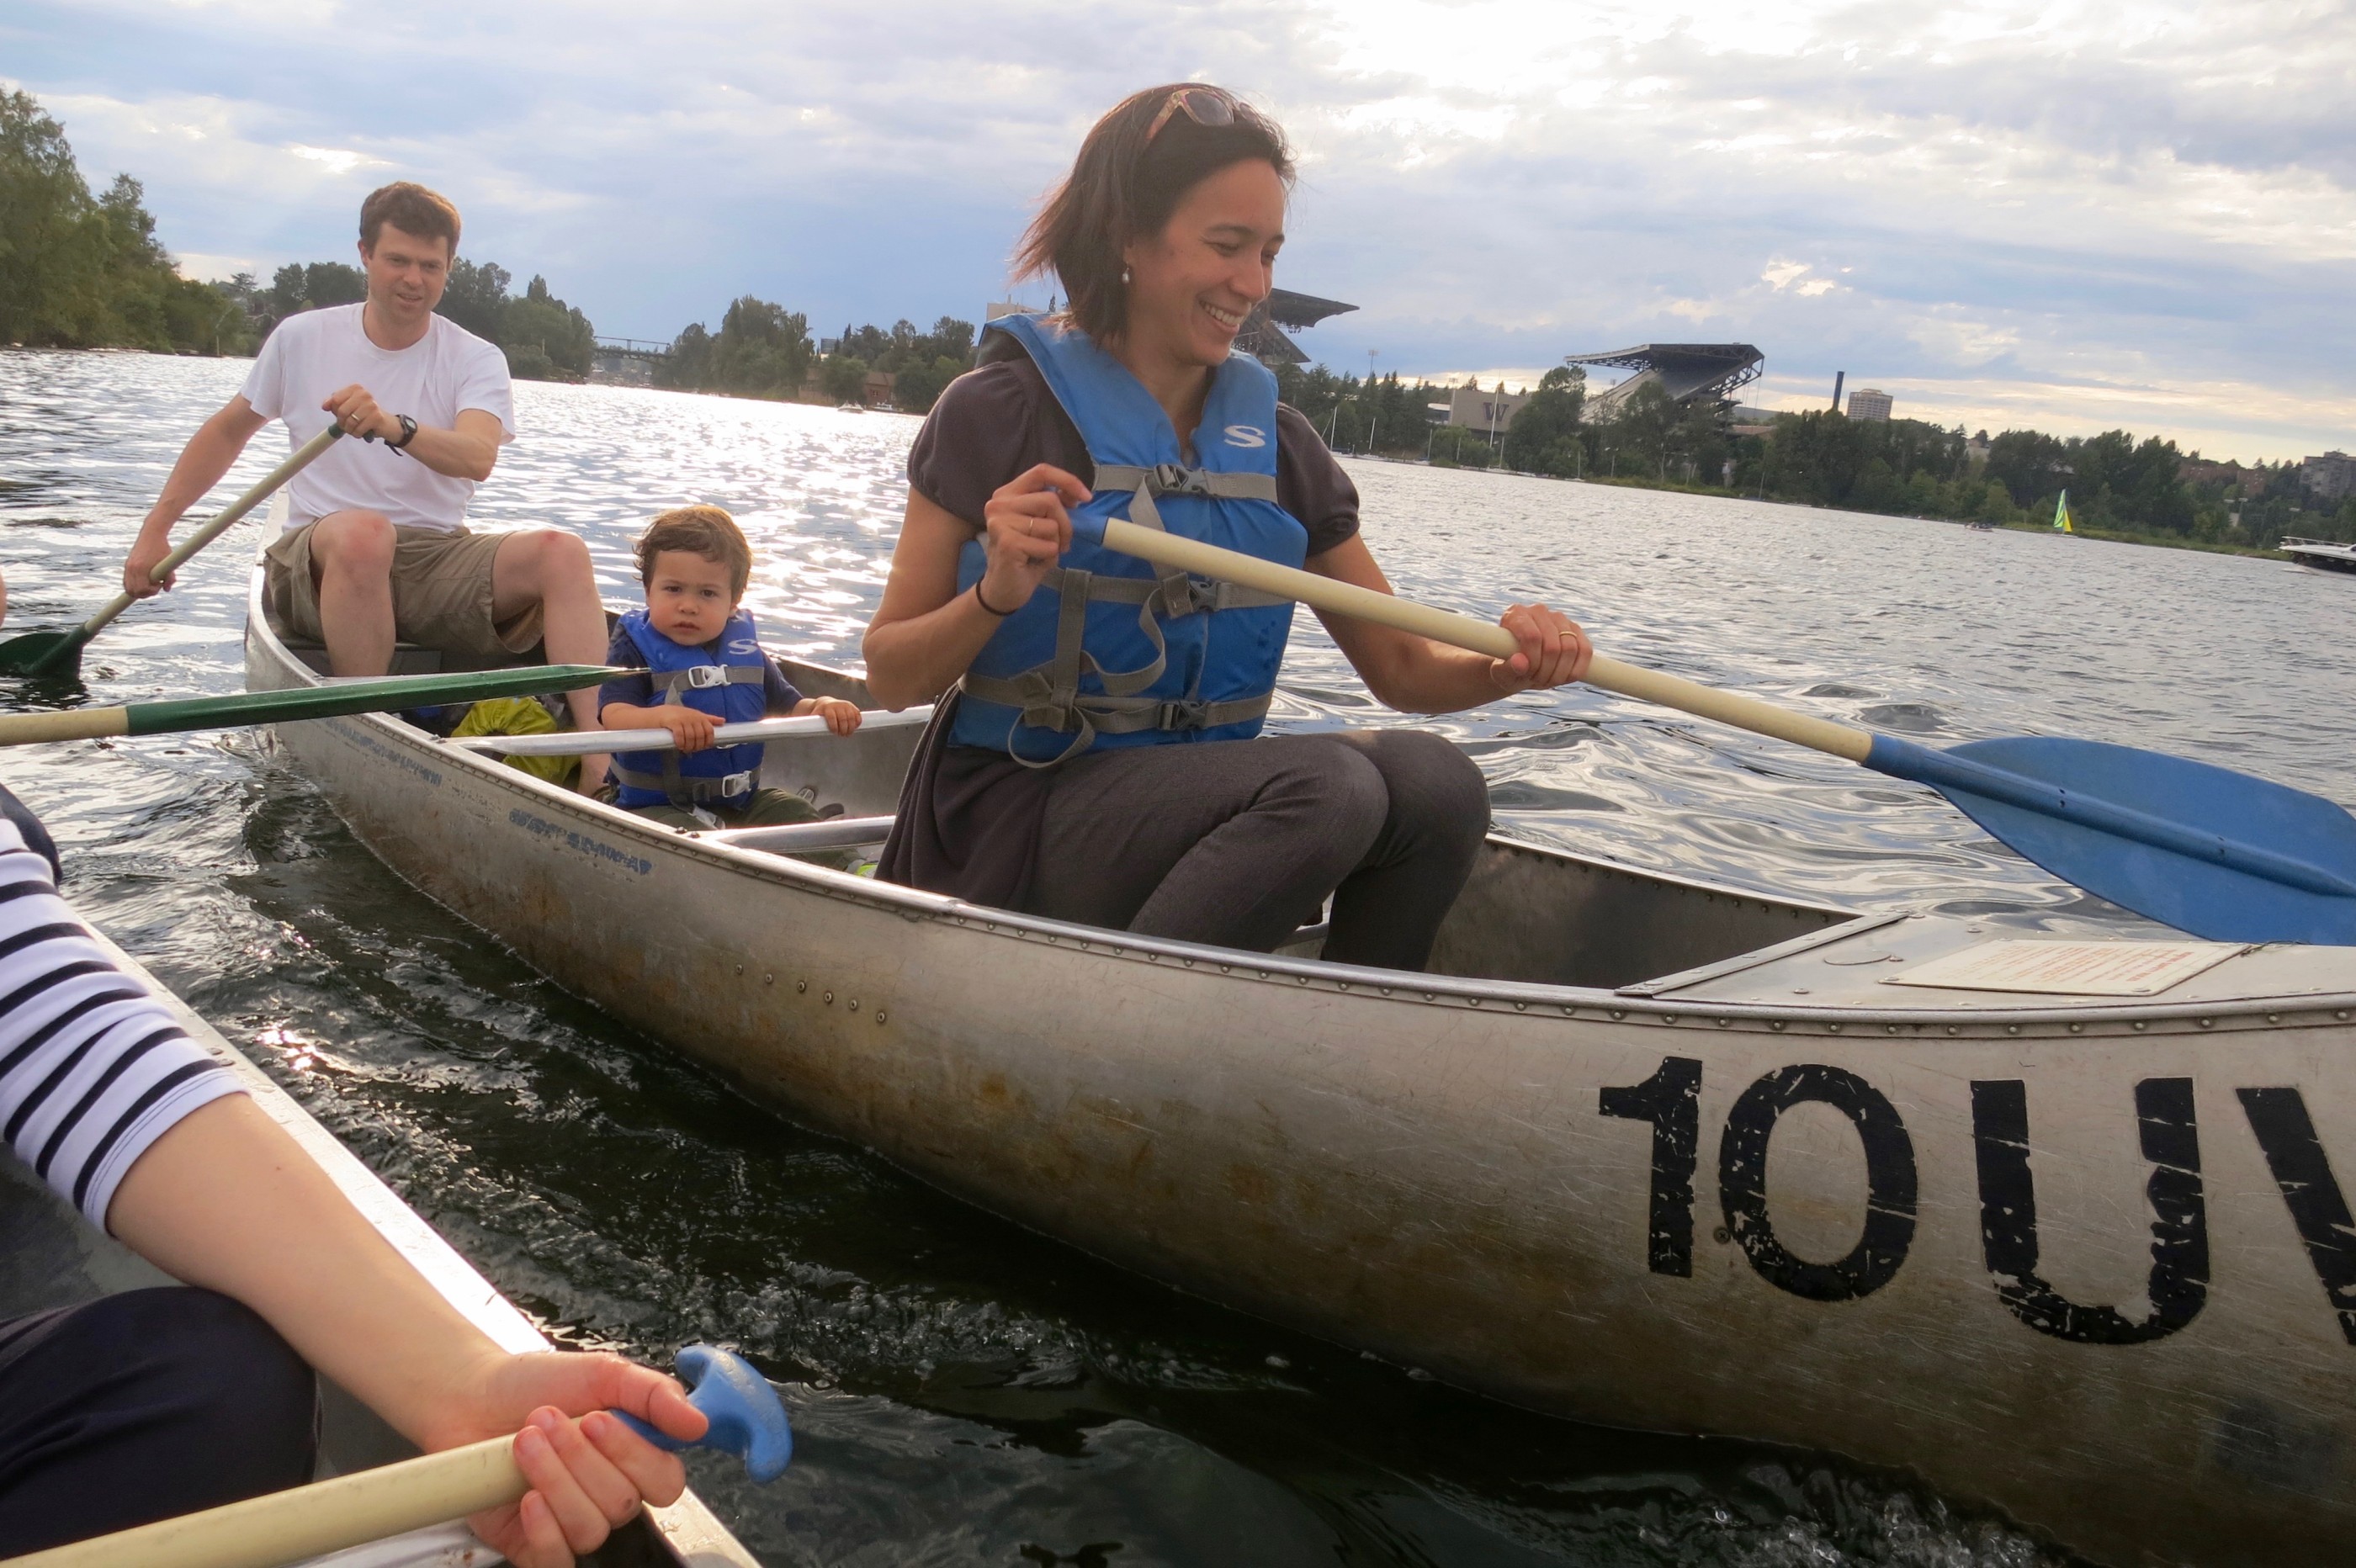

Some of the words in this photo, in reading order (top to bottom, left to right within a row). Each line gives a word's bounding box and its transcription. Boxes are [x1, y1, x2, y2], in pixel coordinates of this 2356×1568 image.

[1483, 401, 1510, 421] W
[1223, 425, 1266, 448] S
[728, 638, 758, 655] S
